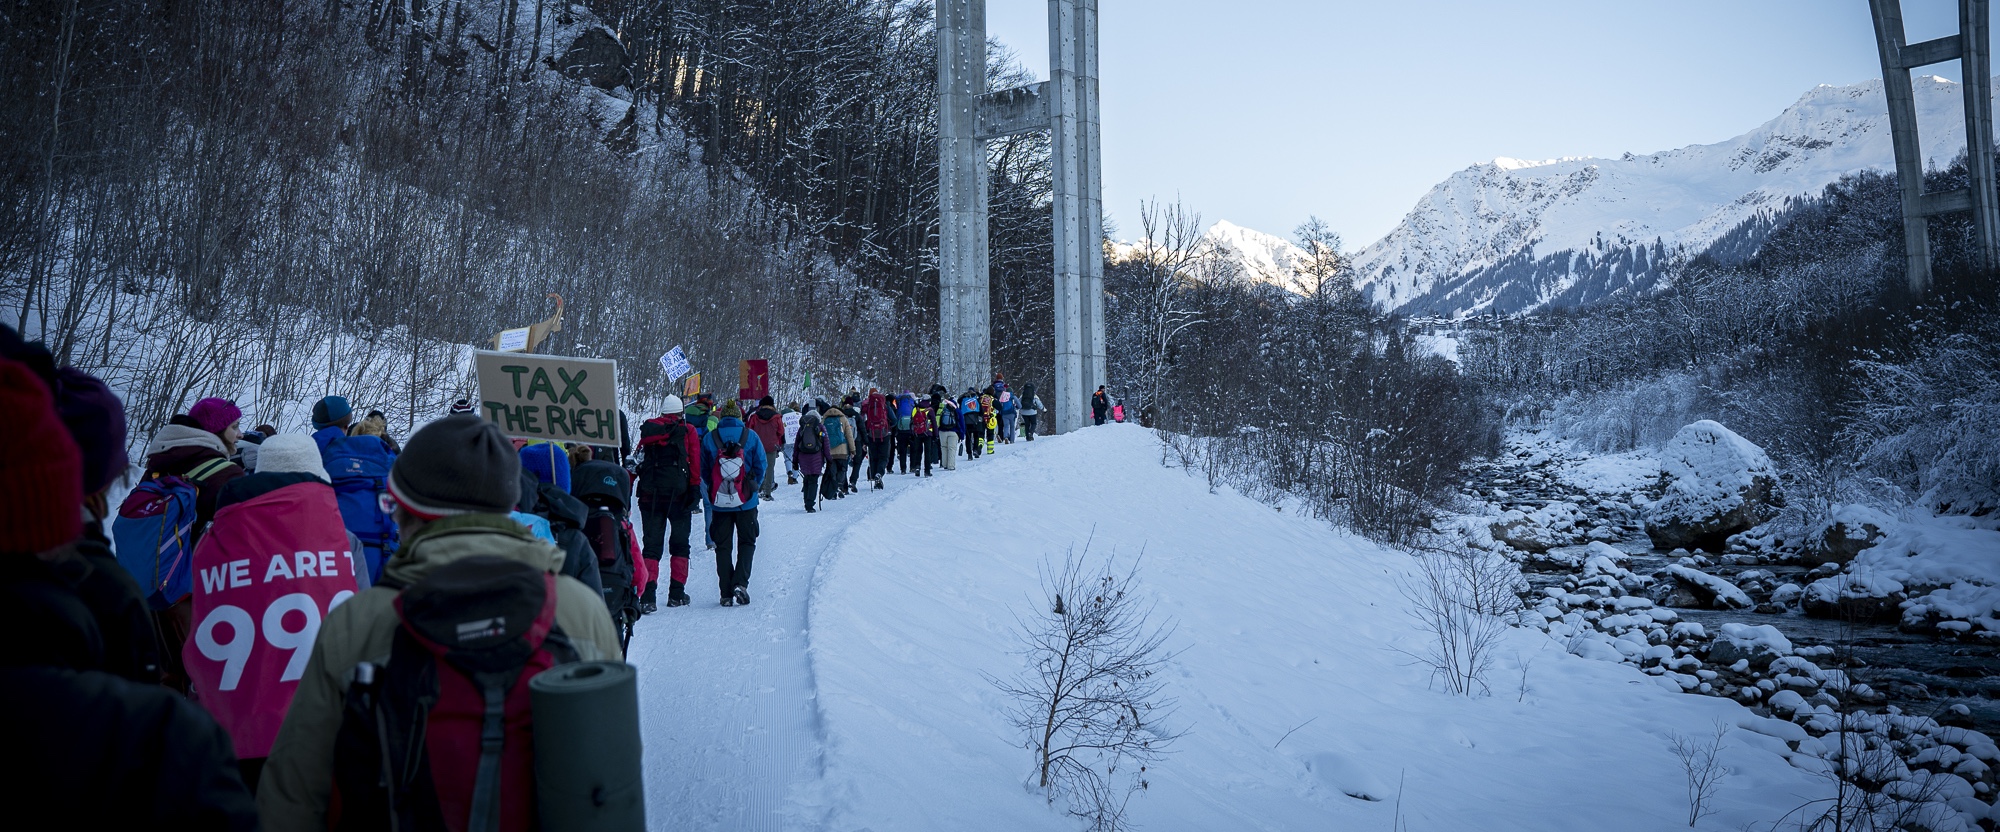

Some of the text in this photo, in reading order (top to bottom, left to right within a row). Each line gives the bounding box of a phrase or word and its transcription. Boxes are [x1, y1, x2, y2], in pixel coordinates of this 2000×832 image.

[501, 365, 589, 406] TAX
[483, 401, 542, 433] THE
[200, 558, 252, 595] WE
[263, 551, 338, 583] ARE
[195, 590, 355, 691] 99
